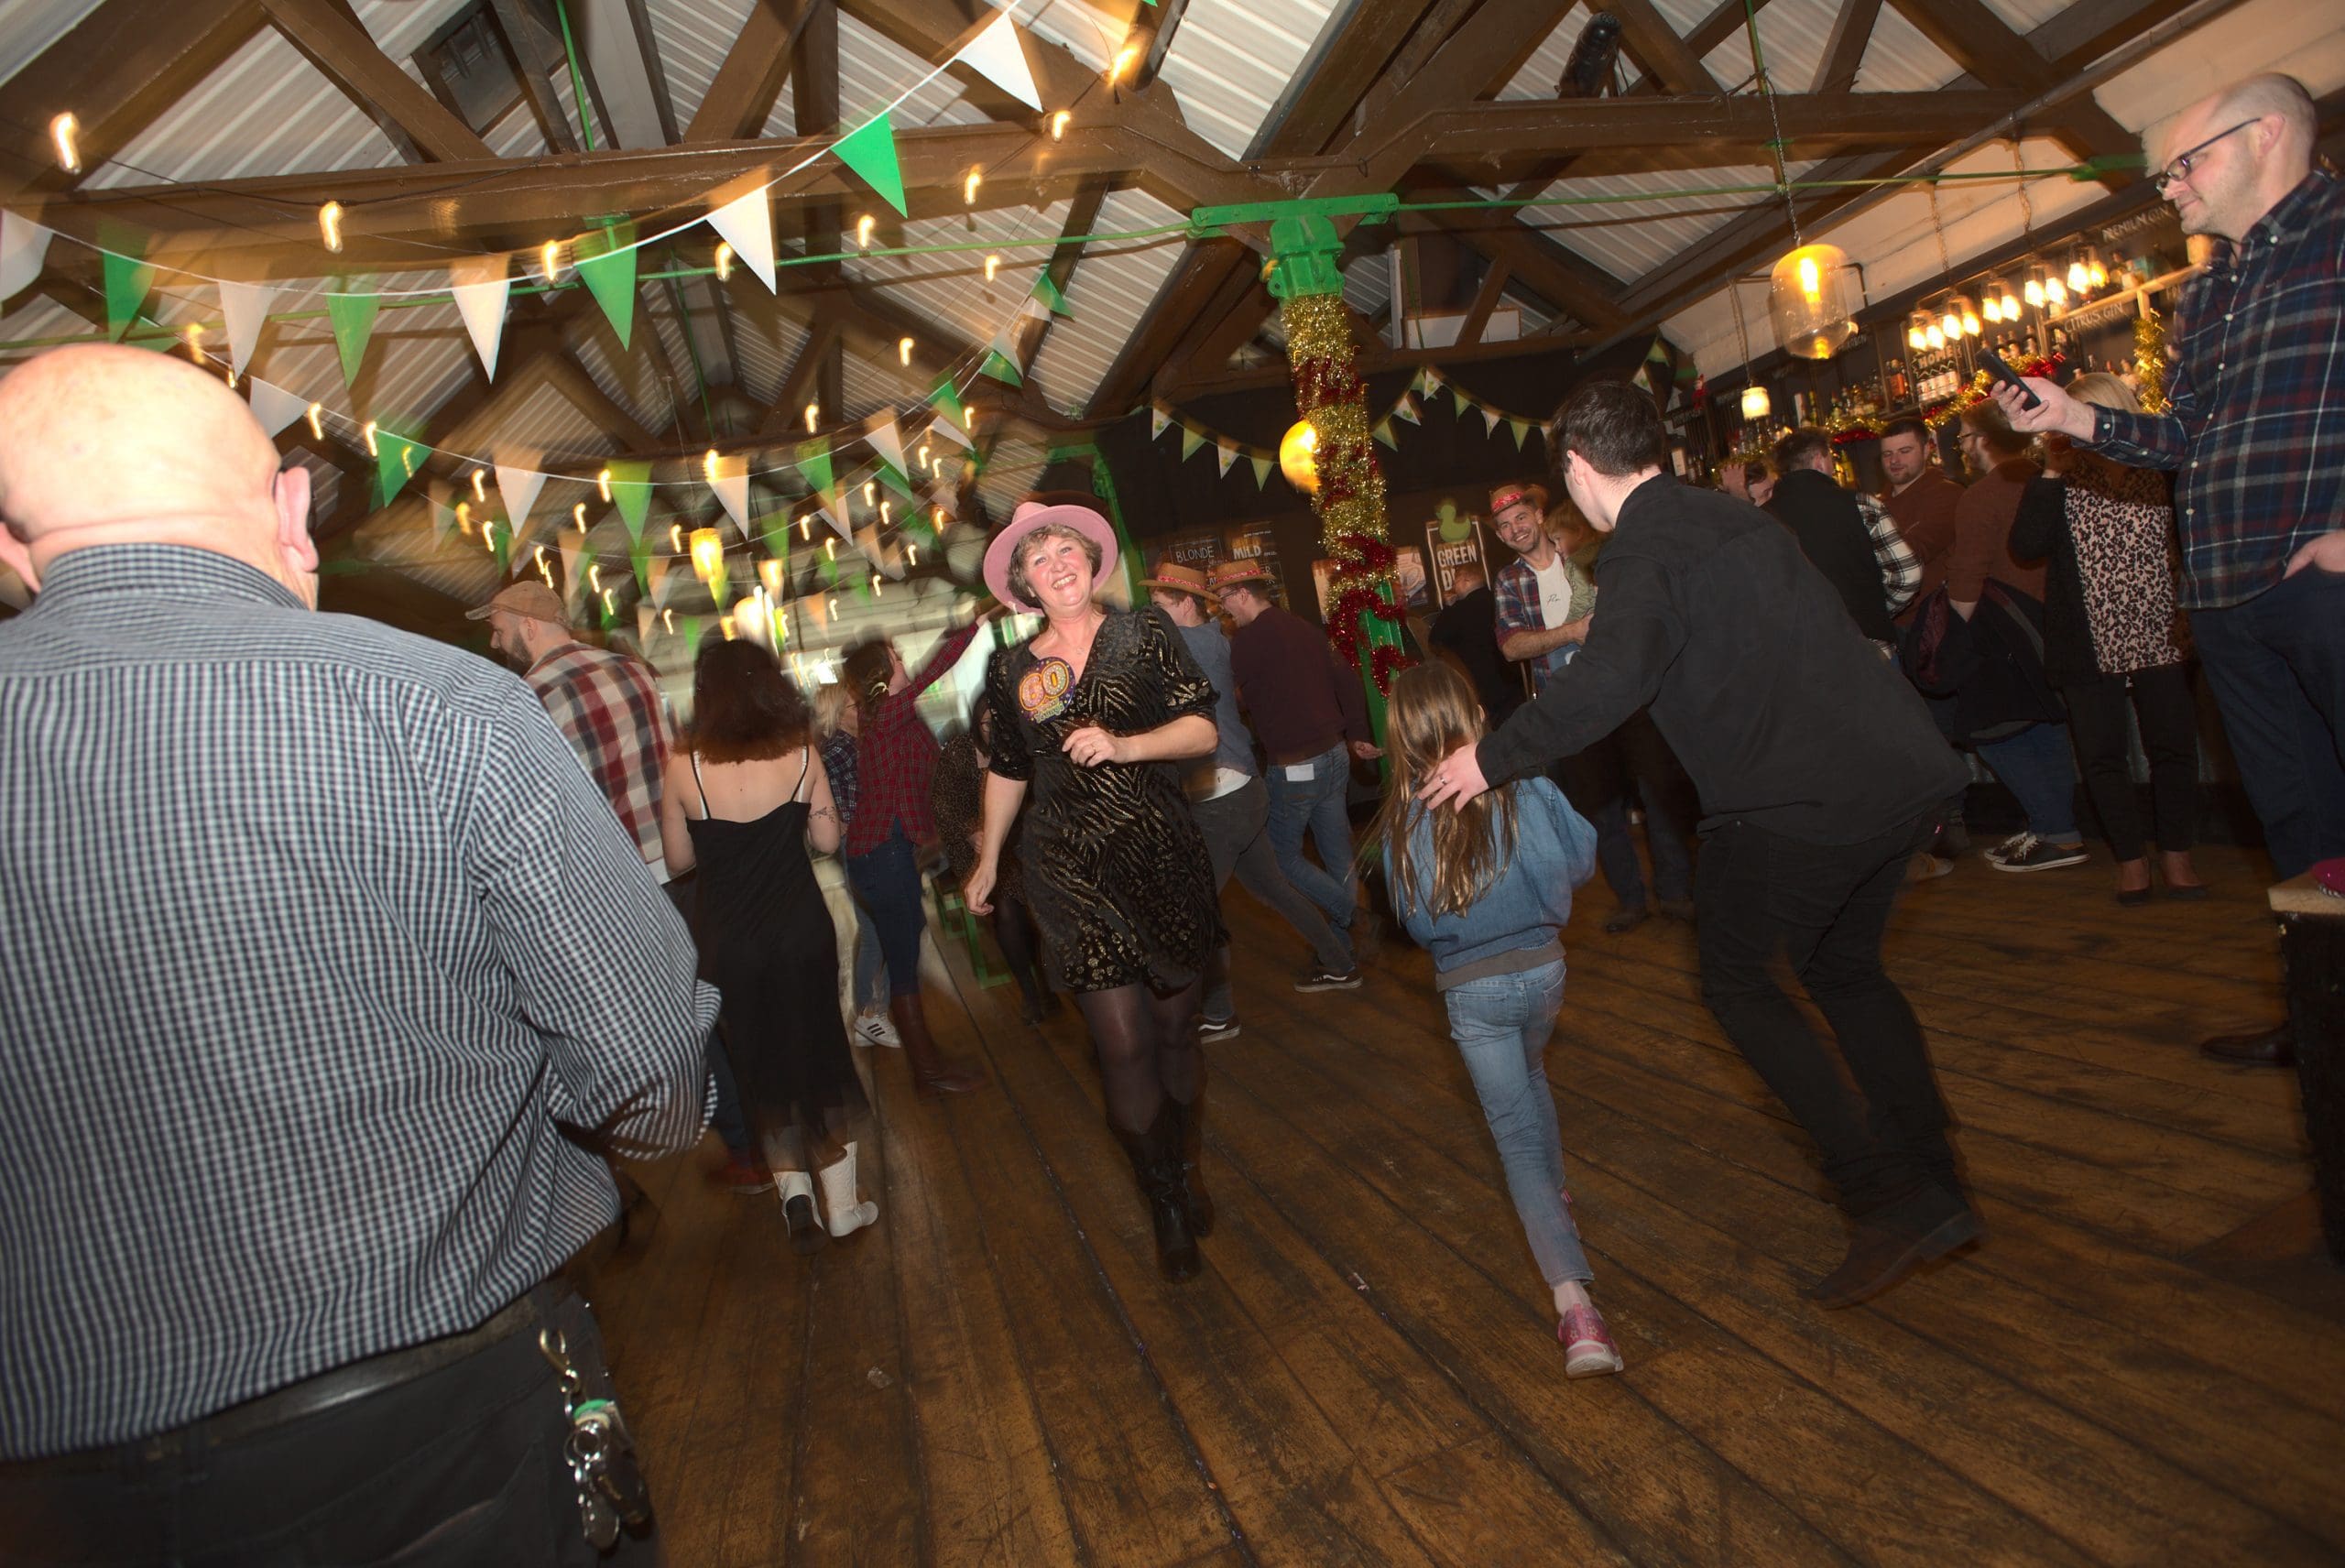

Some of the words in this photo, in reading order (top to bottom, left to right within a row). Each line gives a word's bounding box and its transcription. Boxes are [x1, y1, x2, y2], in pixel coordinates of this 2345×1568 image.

[2065, 310, 2101, 332] CITRUS
[2103, 301, 2123, 318] GIN
[1175, 546, 1215, 563] BLONDE
[1233, 545, 1261, 560] MILD
[1437, 544, 1478, 568] GREEN
[1020, 661, 1069, 711] 60
